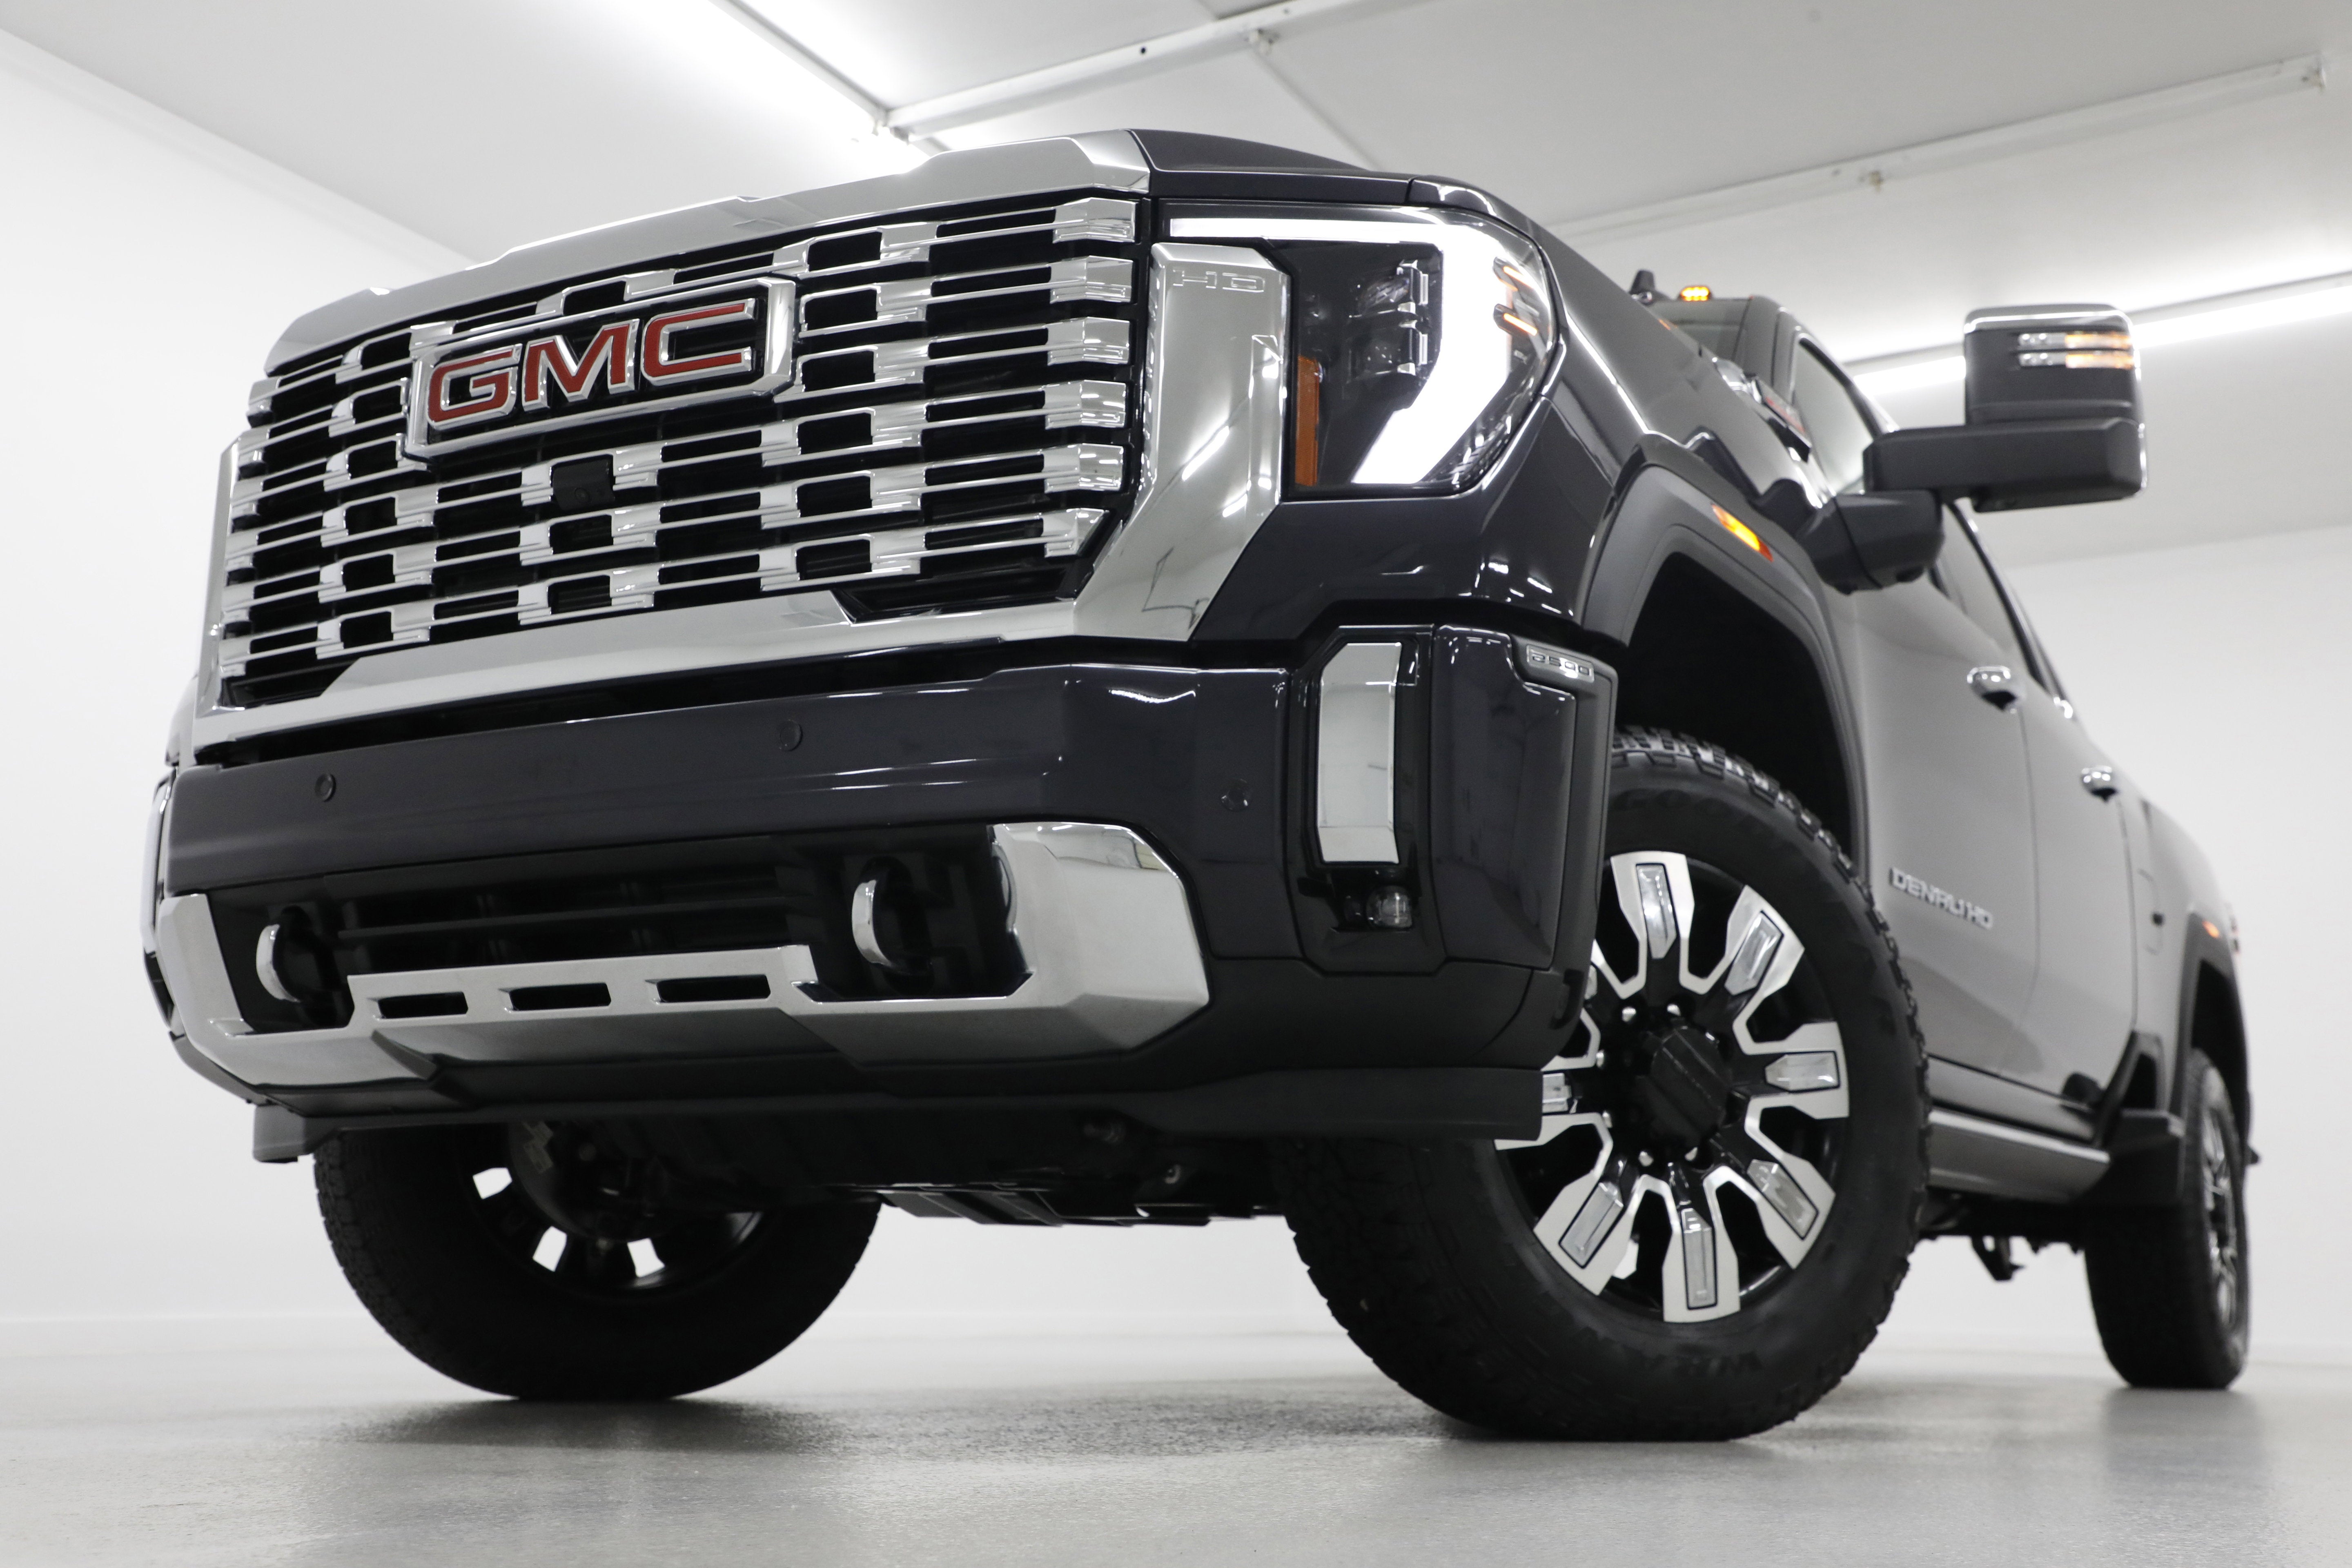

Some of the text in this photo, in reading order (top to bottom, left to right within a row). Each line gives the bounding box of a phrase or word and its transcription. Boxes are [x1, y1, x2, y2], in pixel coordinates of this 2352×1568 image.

[1173, 269, 1265, 292] HD
[427, 298, 757, 431] GMC
[1529, 649, 1593, 678] 2500
